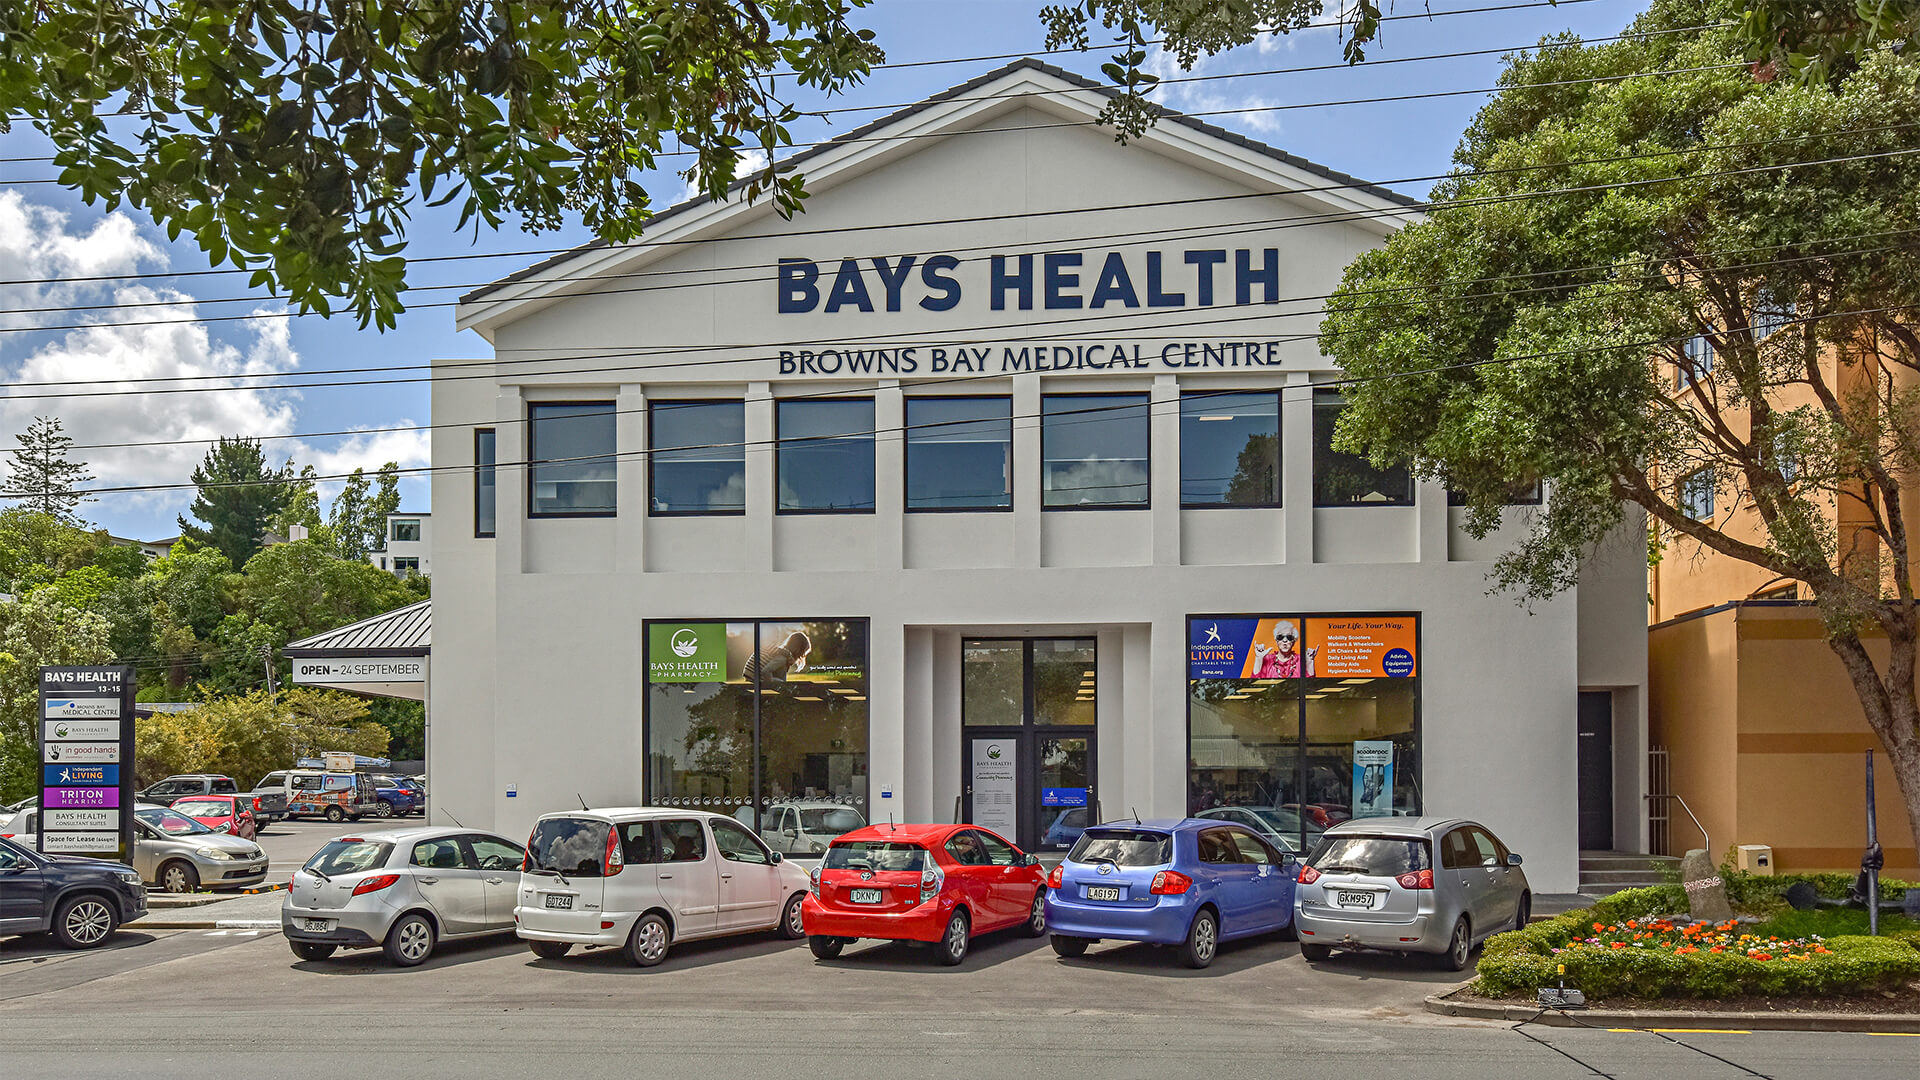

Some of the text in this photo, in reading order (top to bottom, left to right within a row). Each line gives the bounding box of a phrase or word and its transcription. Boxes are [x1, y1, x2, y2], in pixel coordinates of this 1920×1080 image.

[778, 248, 1279, 313] BAYS HEALTH
[779, 341, 1282, 375] BROWNS BAY MEDICAL CENTRE
[1191, 652, 1234, 660] LIVING
[301, 666, 330, 674] OPEN
[340, 665, 352, 674] 24
[354, 664, 420, 674] SEPTEMBER
[45, 672, 120, 681] BAYS HEALTH
[1089, 888, 1117, 897] LAG197
[1339, 894, 1372, 903] GKM957
